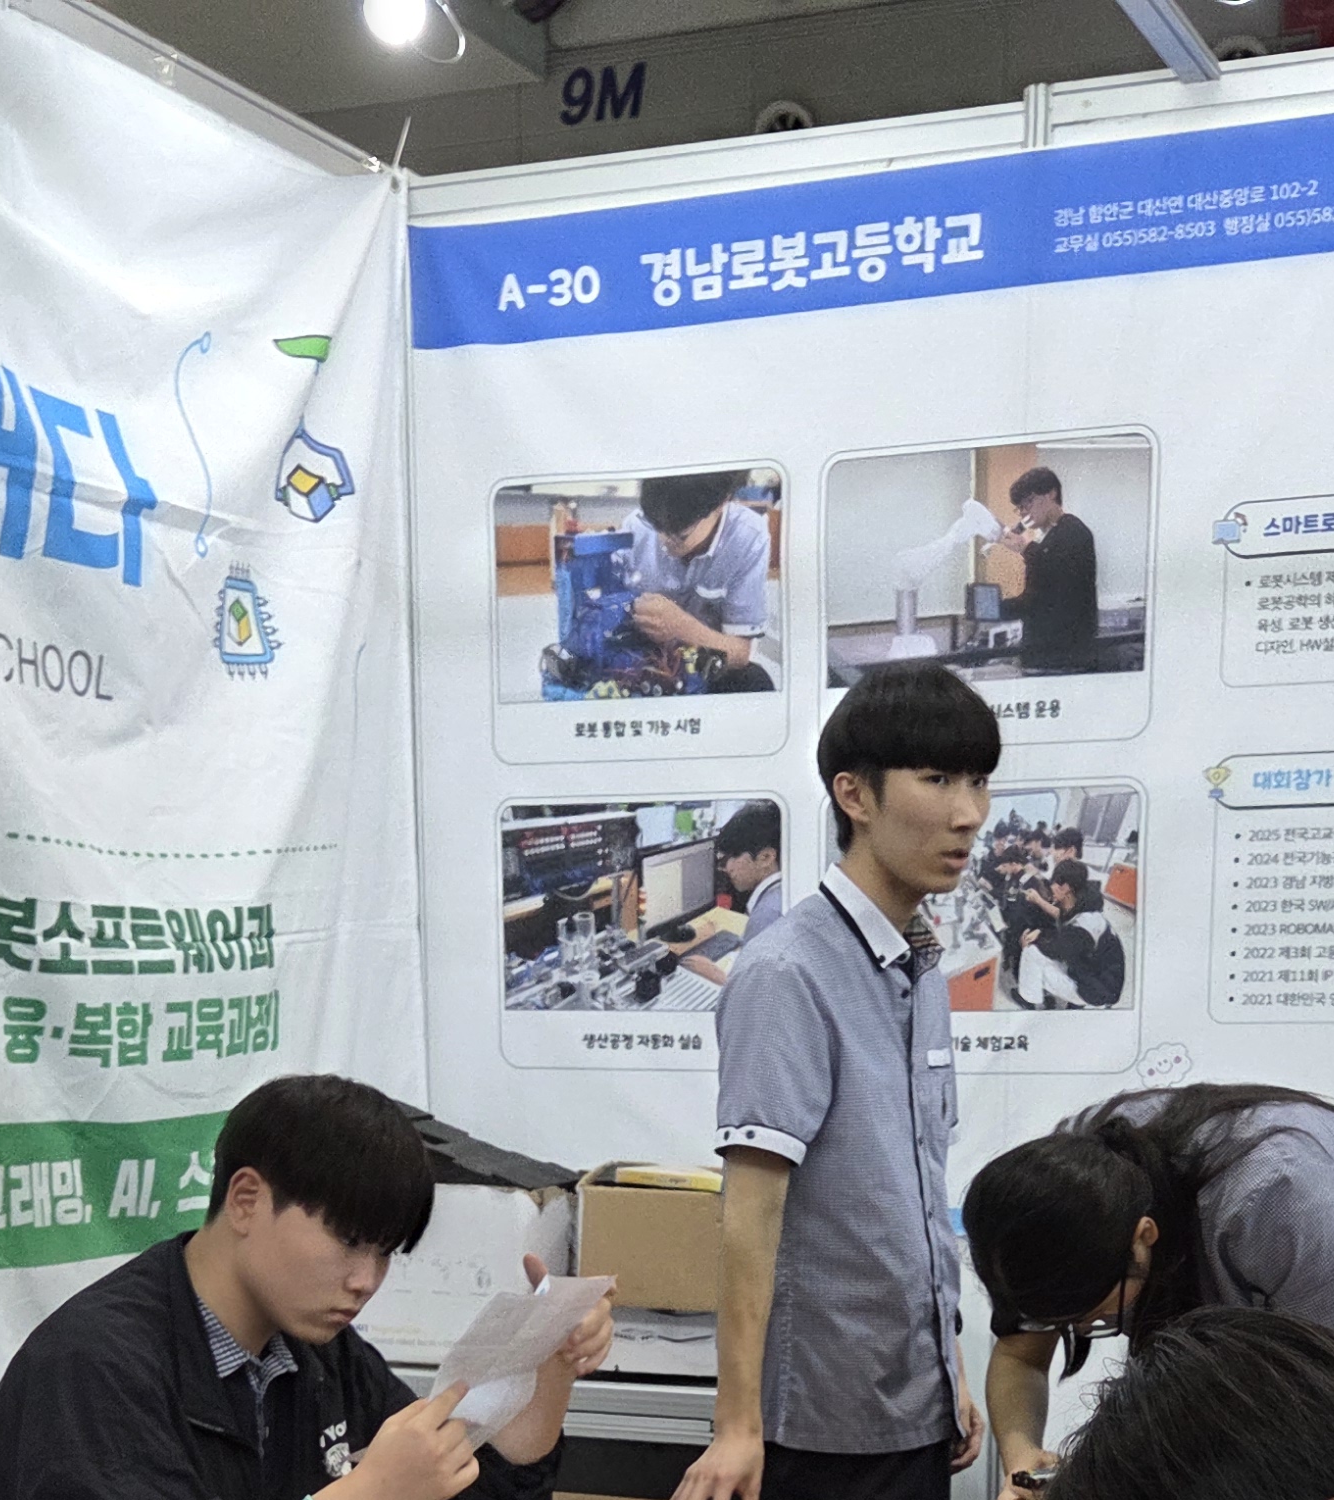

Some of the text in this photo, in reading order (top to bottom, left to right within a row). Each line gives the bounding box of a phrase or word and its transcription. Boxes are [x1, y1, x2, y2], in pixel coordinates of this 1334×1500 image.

[560, 61, 647, 126] 9M
[1054, 206, 1085, 227] 경남
[1270, 180, 1318, 200] 102-2
[1054, 233, 1099, 253] 교무실
[1102, 220, 1216, 247] 055)582-8503
[498, 213, 984, 312] A-30 경남로봇고등학교
[674, 718, 701, 734] 시험
[1252, 769, 1332, 791] 대회참가
[1249, 829, 1281, 842] 2025
[1247, 853, 1279, 865] 2024
[1246, 876, 1278, 889] 2023
[1245, 900, 1278, 912] 2023
[1244, 923, 1277, 936] 2023
[1243, 947, 1275, 959] 2022
[1243, 970, 1274, 983] 2021
[1322, 970, 1334, 981] IP
[1241, 993, 1272, 1005] 2021
[108, 1158, 161, 1220] AI,
